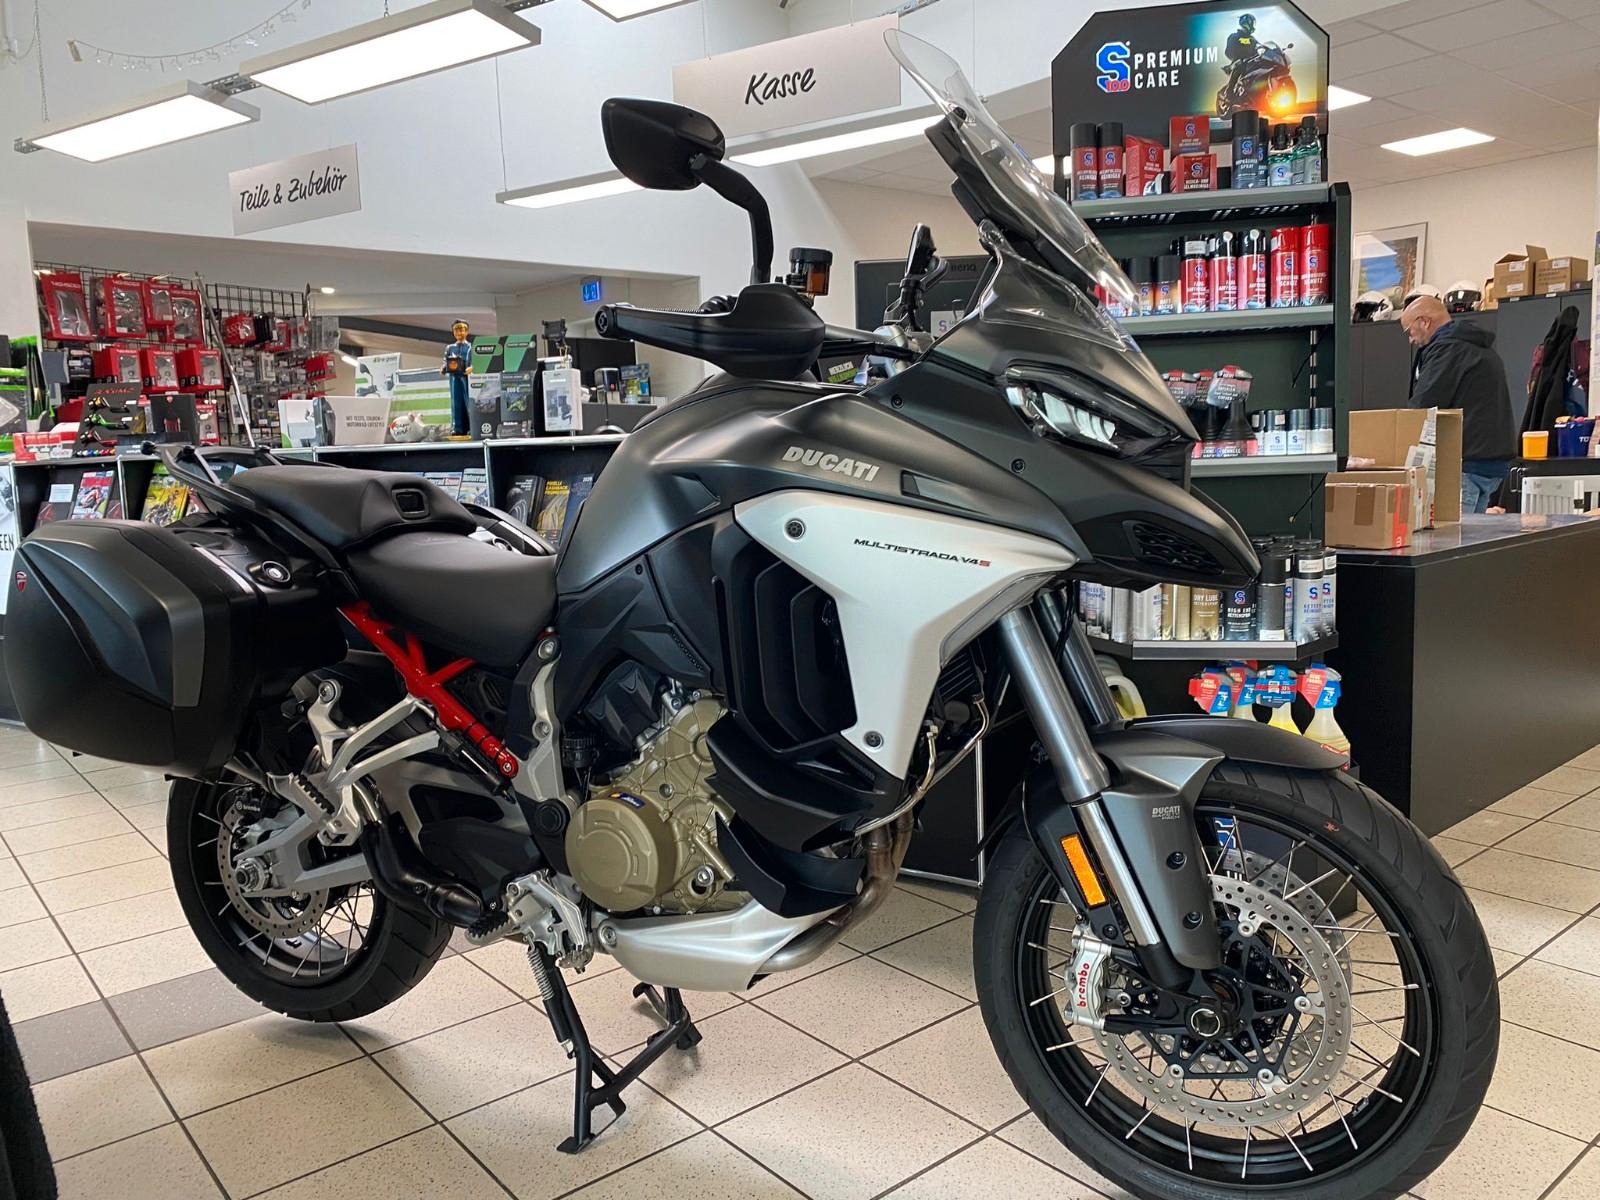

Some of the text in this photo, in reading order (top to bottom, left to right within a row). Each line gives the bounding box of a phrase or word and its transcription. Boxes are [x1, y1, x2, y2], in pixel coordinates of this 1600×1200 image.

[1134, 46, 1218, 70] PREMIUM
[745, 67, 816, 105] Kasse
[1134, 70, 1180, 90] CARE
[239, 165, 348, 212] Teile & Zubehör
[782, 446, 880, 482] DUCATI
[854, 538, 960, 562] MULTISTRADA
[1152, 805, 1180, 816] DUCATI
[1077, 963, 1090, 1008] brembo
